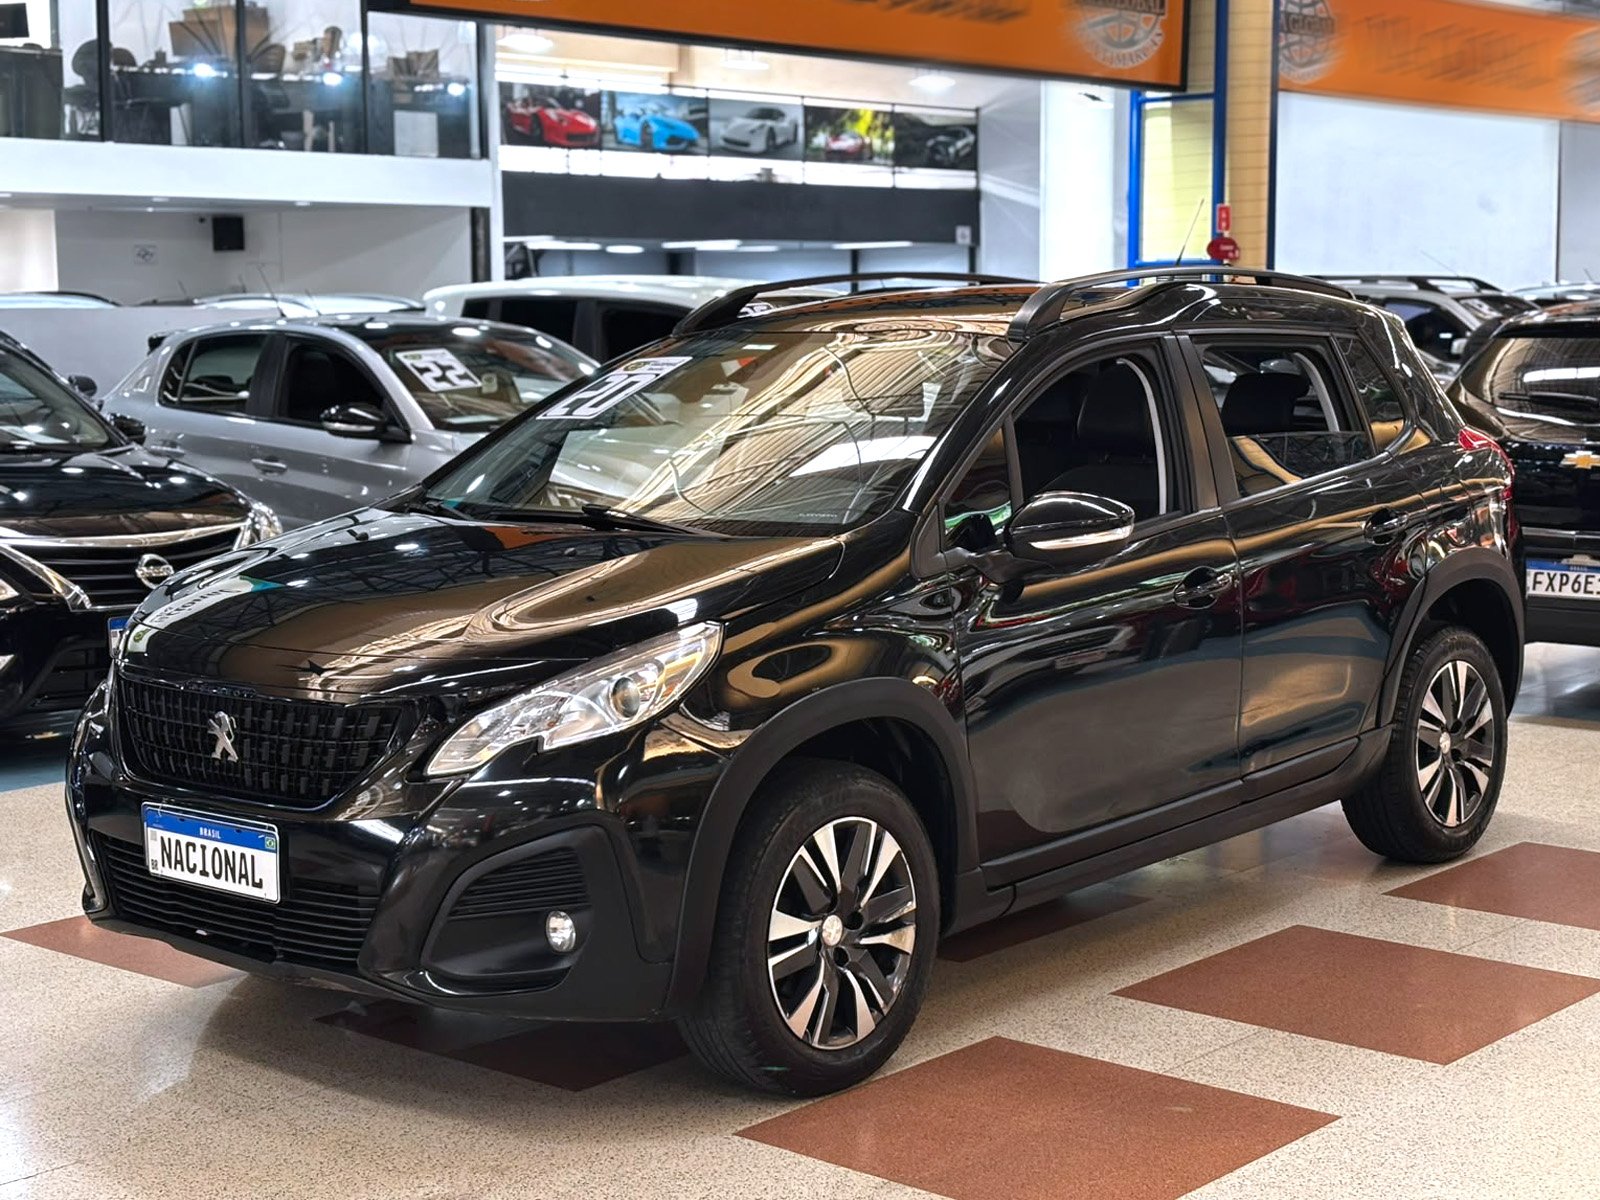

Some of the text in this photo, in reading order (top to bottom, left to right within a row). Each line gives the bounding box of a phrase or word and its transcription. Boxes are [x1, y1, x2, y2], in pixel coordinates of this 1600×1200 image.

[410, 360, 478, 390] 22
[544, 373, 659, 417] 20
[200, 826, 221, 839] BRASIL
[160, 835, 263, 889] NACIONAL
